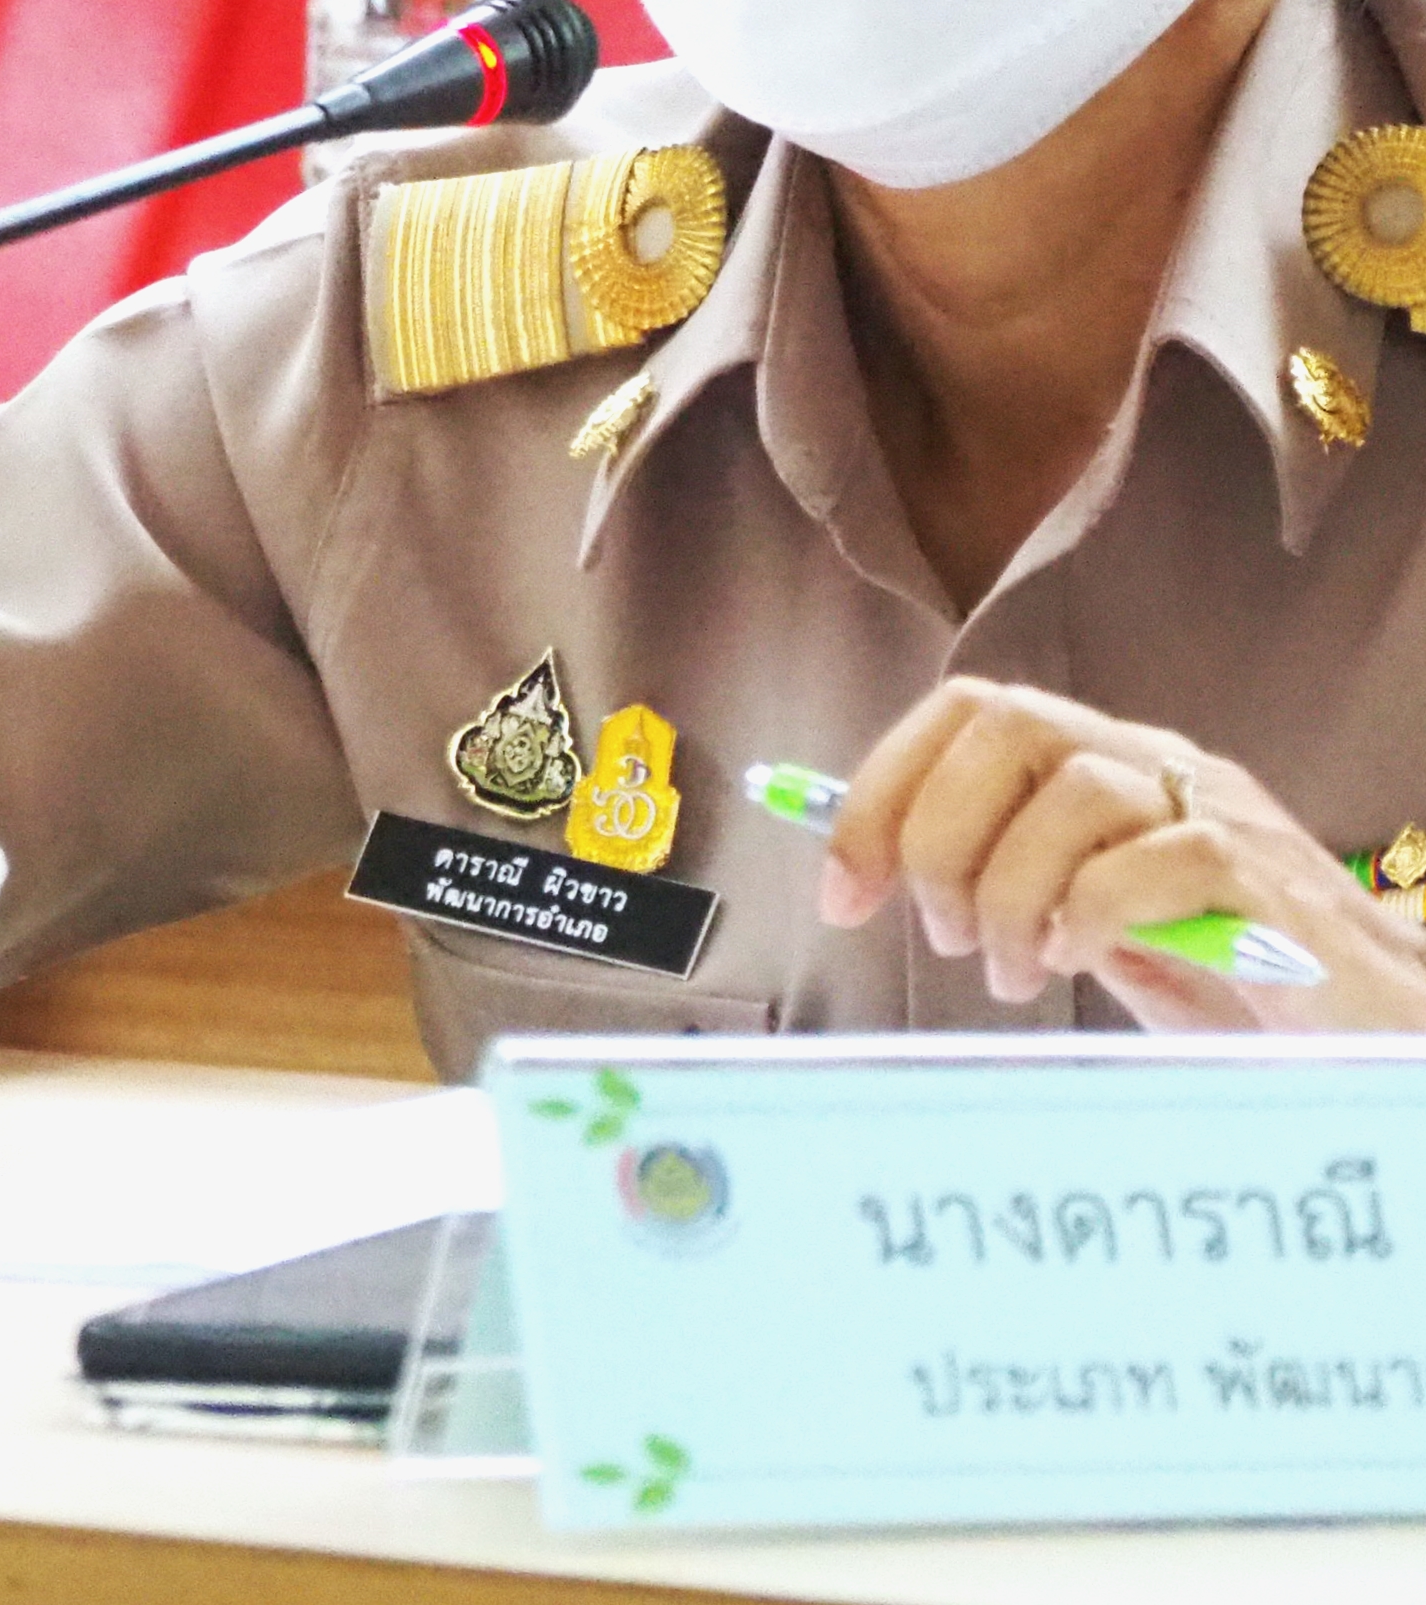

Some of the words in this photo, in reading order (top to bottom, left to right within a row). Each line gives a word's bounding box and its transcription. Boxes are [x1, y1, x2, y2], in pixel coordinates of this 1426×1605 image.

[426, 877, 609, 943] พัฒนาการอำเภอ
[434, 848, 529, 887] ดาราณี
[543, 866, 629, 912] ผิวขาว
[858, 1157, 1392, 1264] นางดาราณี
[912, 1350, 1176, 1419] ประเภท
